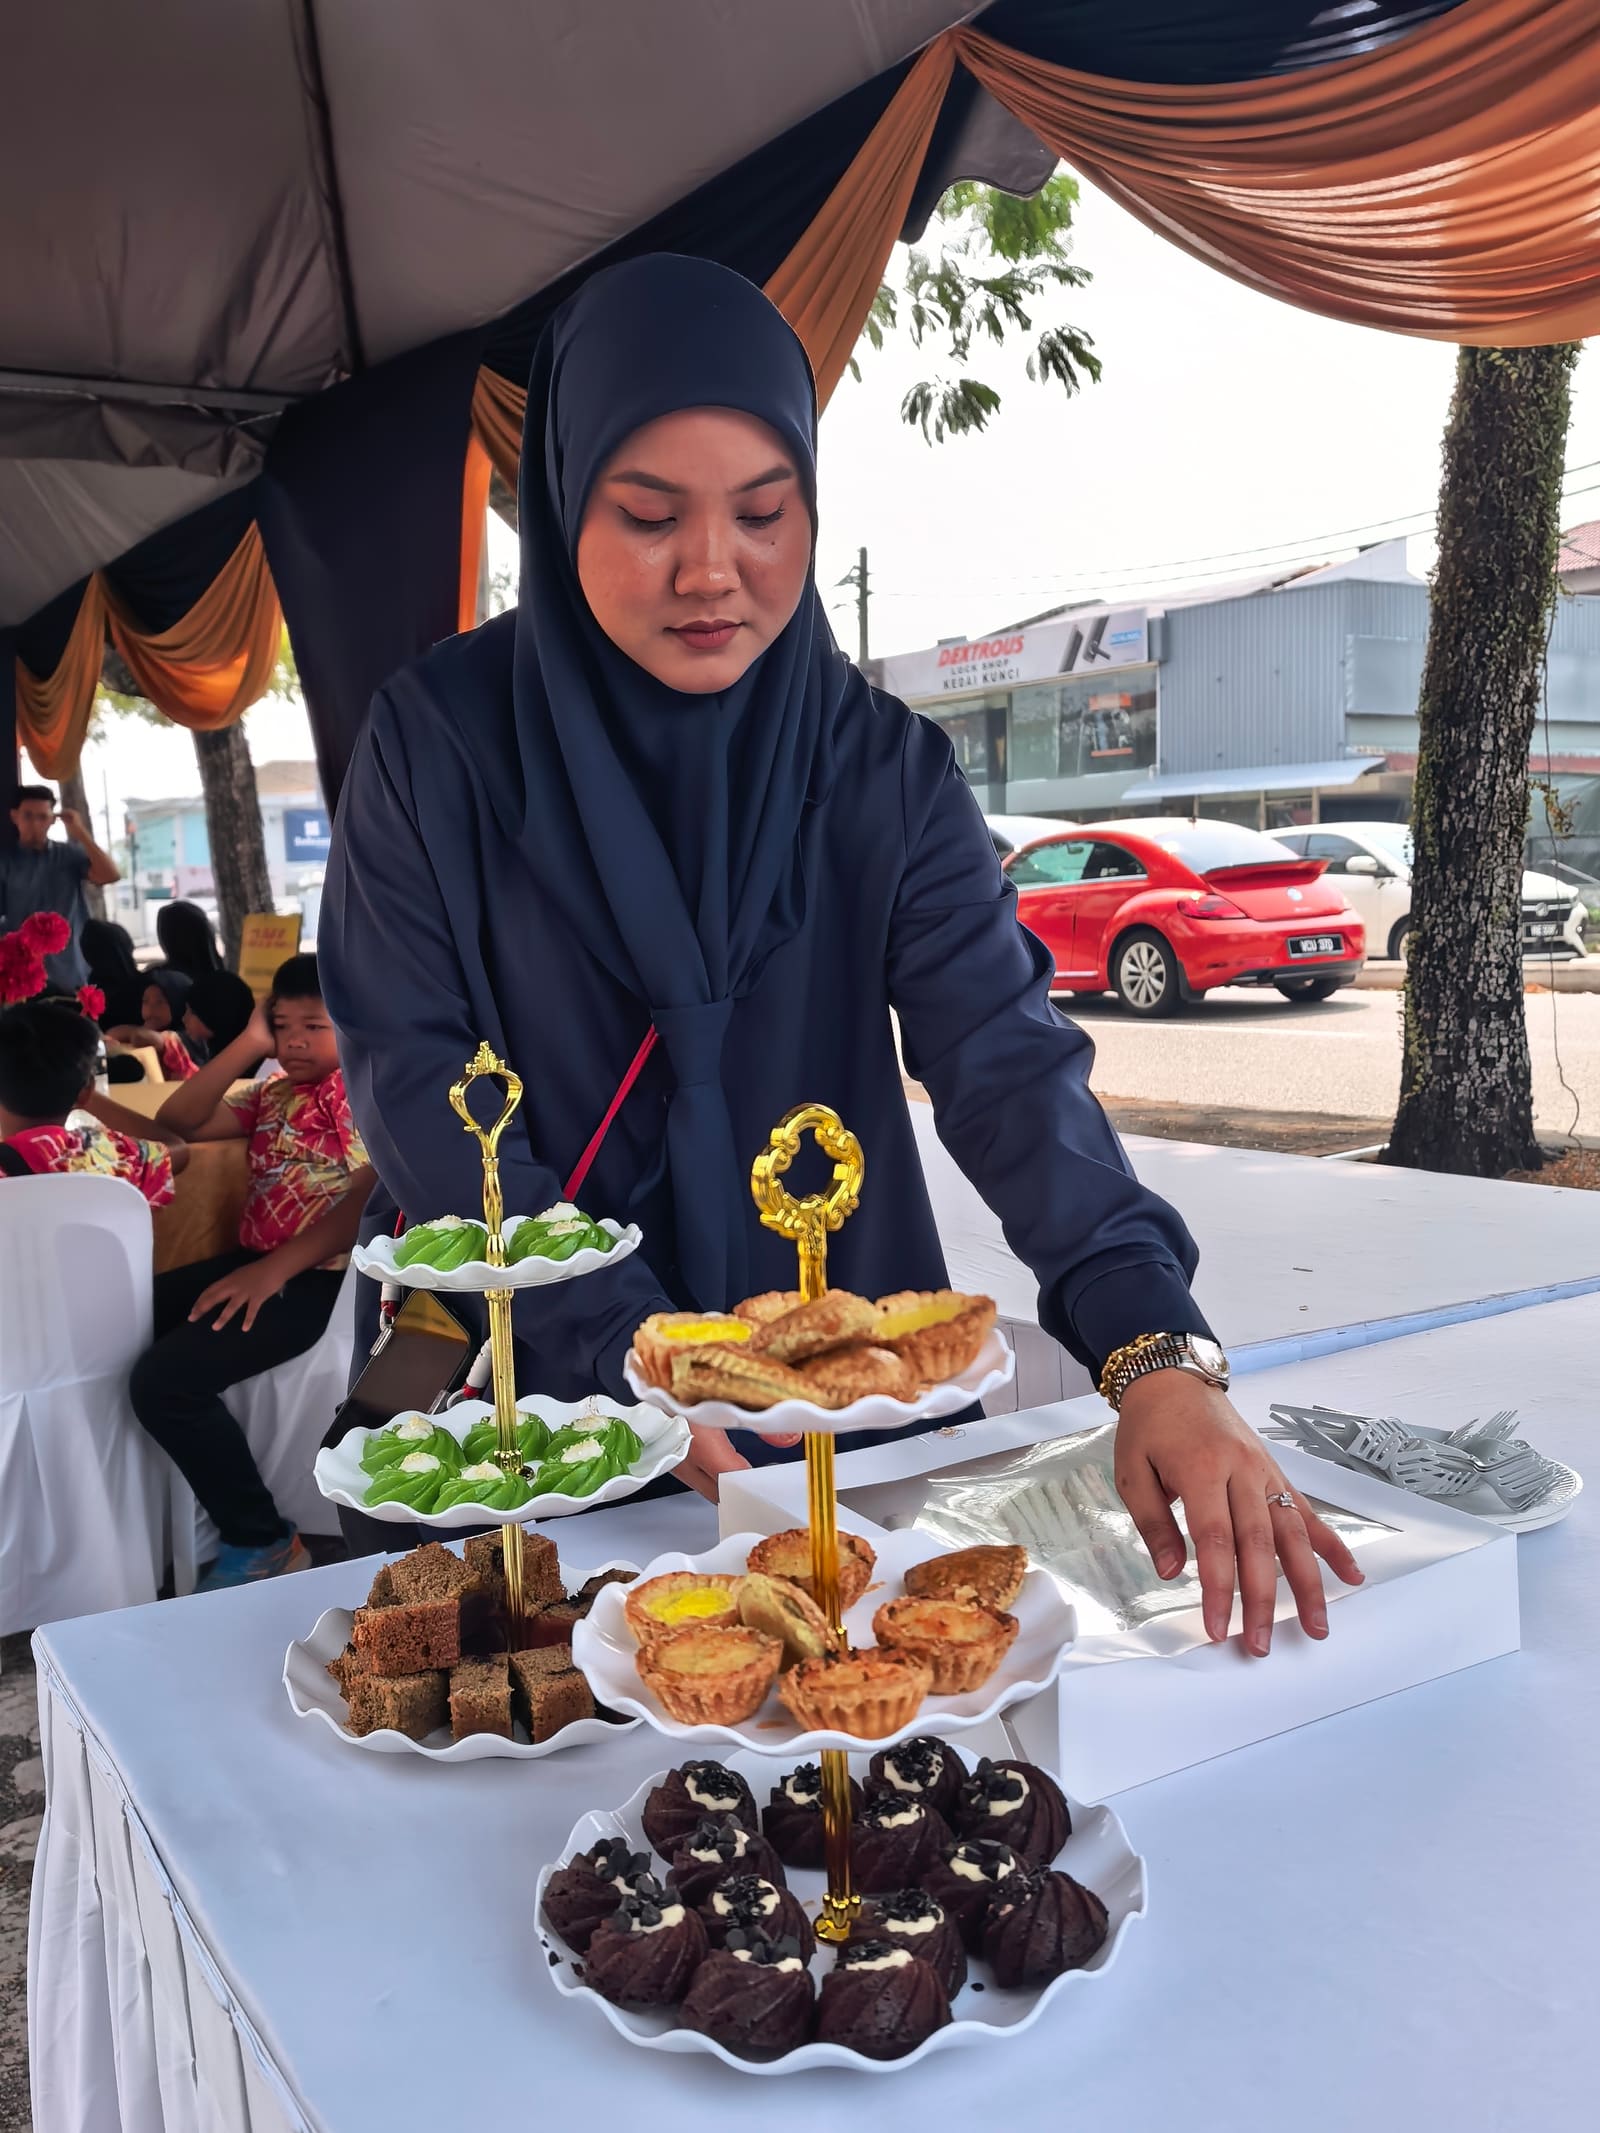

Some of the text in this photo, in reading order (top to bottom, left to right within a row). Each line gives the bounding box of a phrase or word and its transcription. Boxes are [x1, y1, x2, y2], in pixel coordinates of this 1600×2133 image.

[938, 635, 1025, 668] DEXTROUS
[951, 658, 1009, 675] LOCK SHOP
[943, 668, 1019, 689] KEDAI KUNCI
